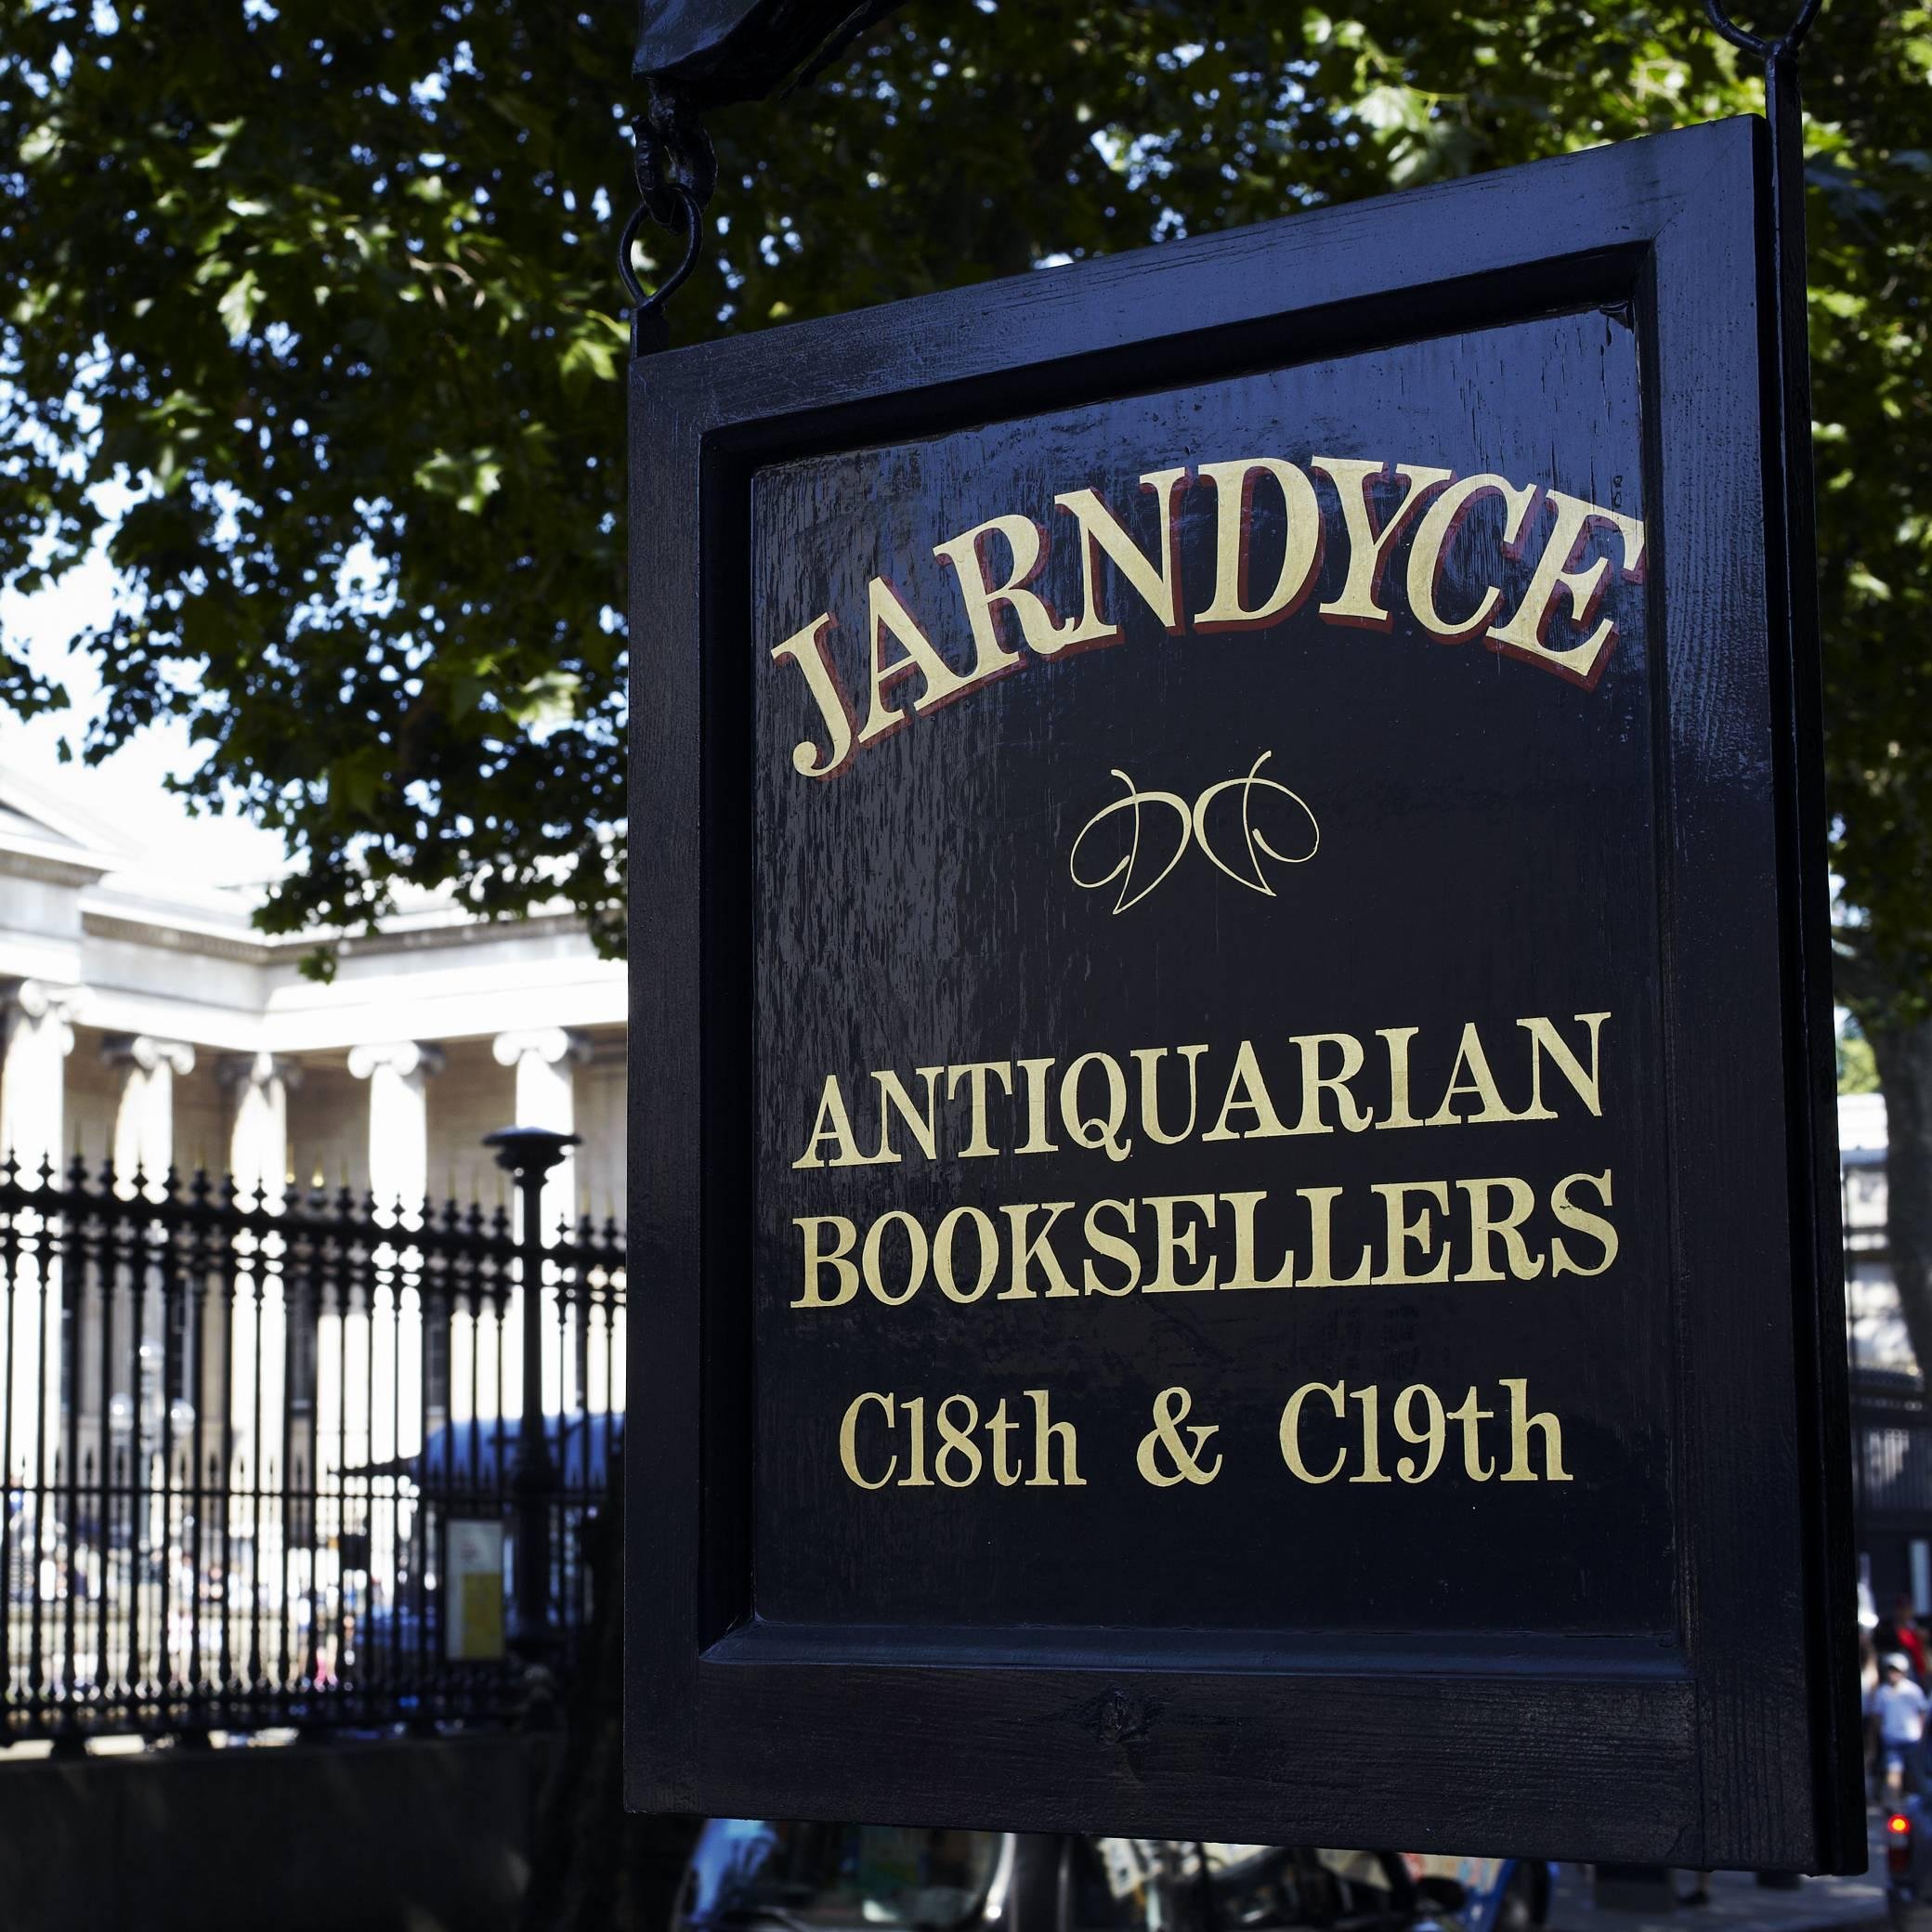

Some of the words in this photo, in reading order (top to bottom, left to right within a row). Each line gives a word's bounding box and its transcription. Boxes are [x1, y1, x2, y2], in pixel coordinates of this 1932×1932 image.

[770, 456, 1645, 779] JARNDYCE
[791, 1012, 1612, 1169] ANTIQUARIAN
[790, 1168, 1619, 1309] BOOKSELLERS
[839, 1390, 1088, 1490] C18th
[1136, 1386, 1222, 1487] &
[1279, 1378, 1573, 1484] C19th
